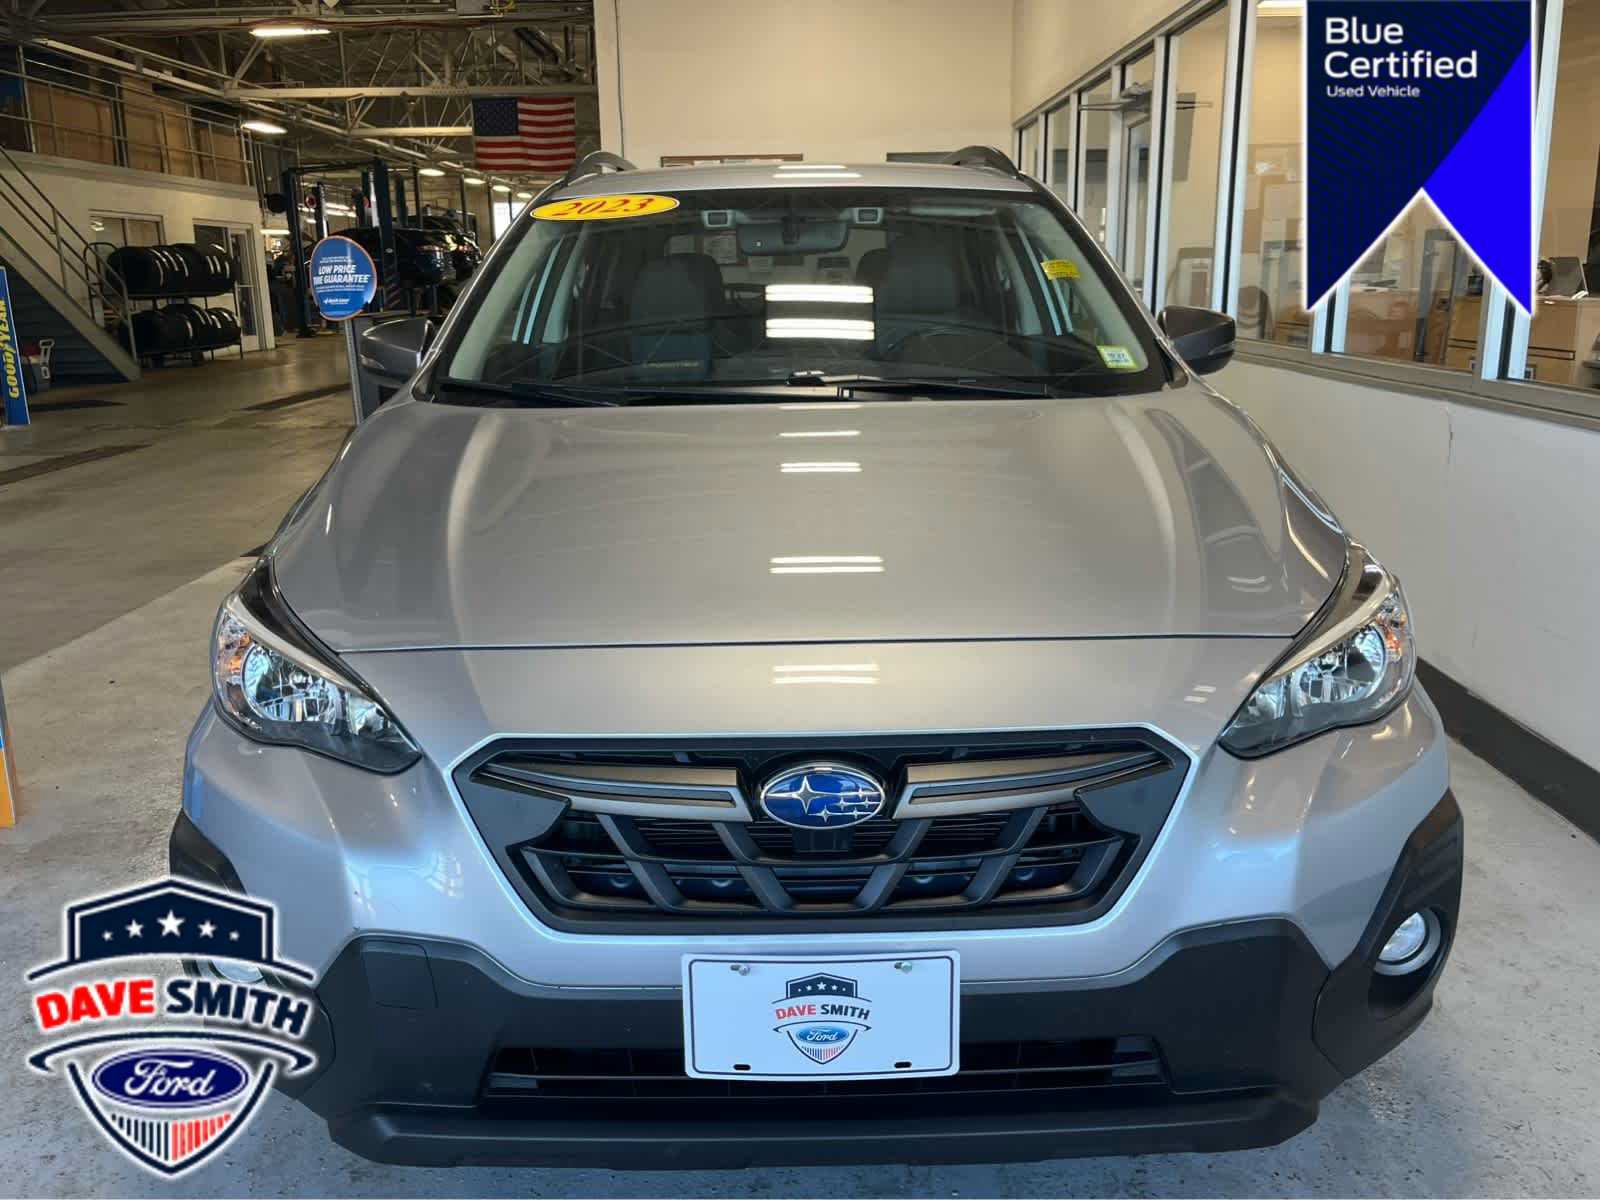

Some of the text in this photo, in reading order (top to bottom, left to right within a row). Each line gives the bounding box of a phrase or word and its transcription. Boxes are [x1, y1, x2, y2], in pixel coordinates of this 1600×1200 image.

[552, 198, 655, 216] 2023
[318, 264, 357, 275] LOW PRICE
[324, 274, 370, 284] GUARANTEE
[775, 1004, 870, 1020] DAVE SMITH
[806, 1028, 839, 1041] Ford
